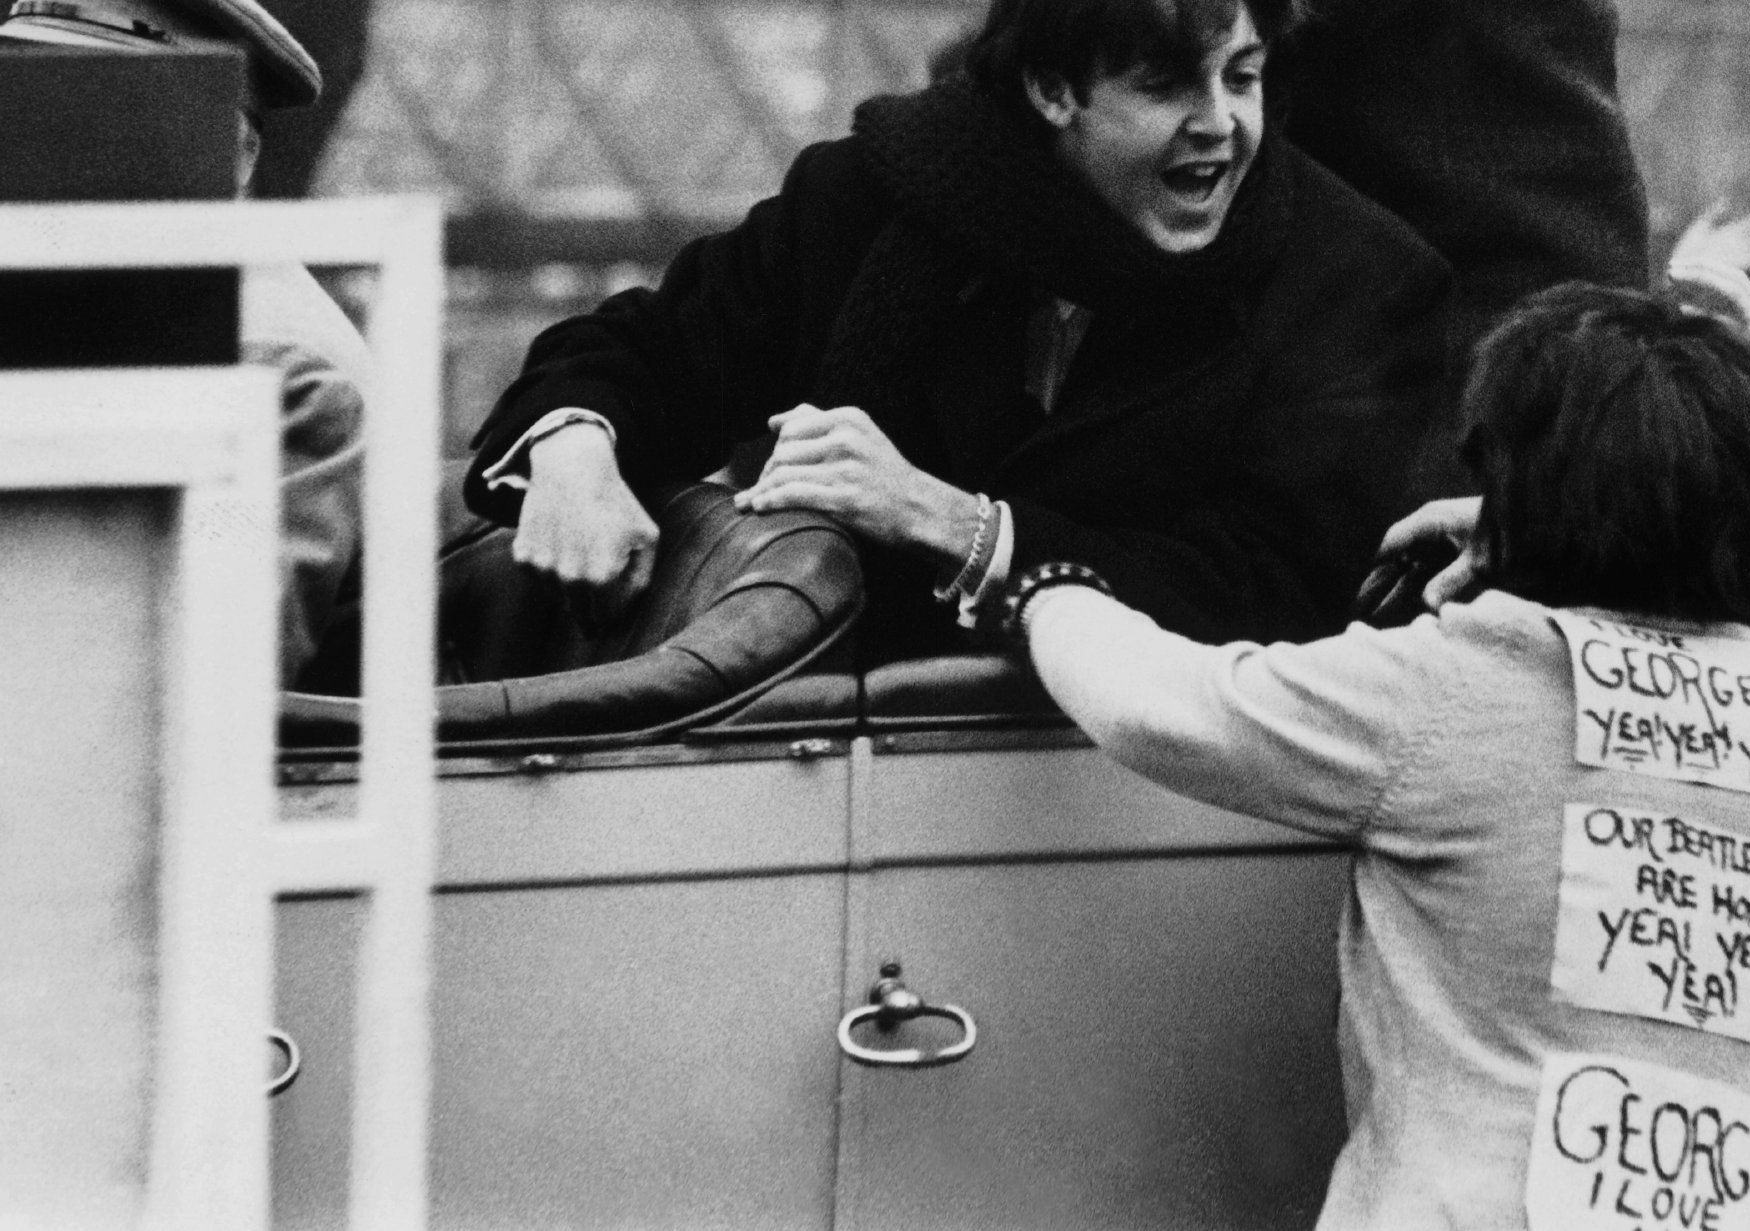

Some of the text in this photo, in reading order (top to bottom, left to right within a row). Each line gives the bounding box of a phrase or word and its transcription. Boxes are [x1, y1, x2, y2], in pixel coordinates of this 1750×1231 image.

[1584, 808, 1664, 863] OUR
[1636, 864, 1698, 910] ARE
[1589, 1170, 1721, 1231] I LOVE
